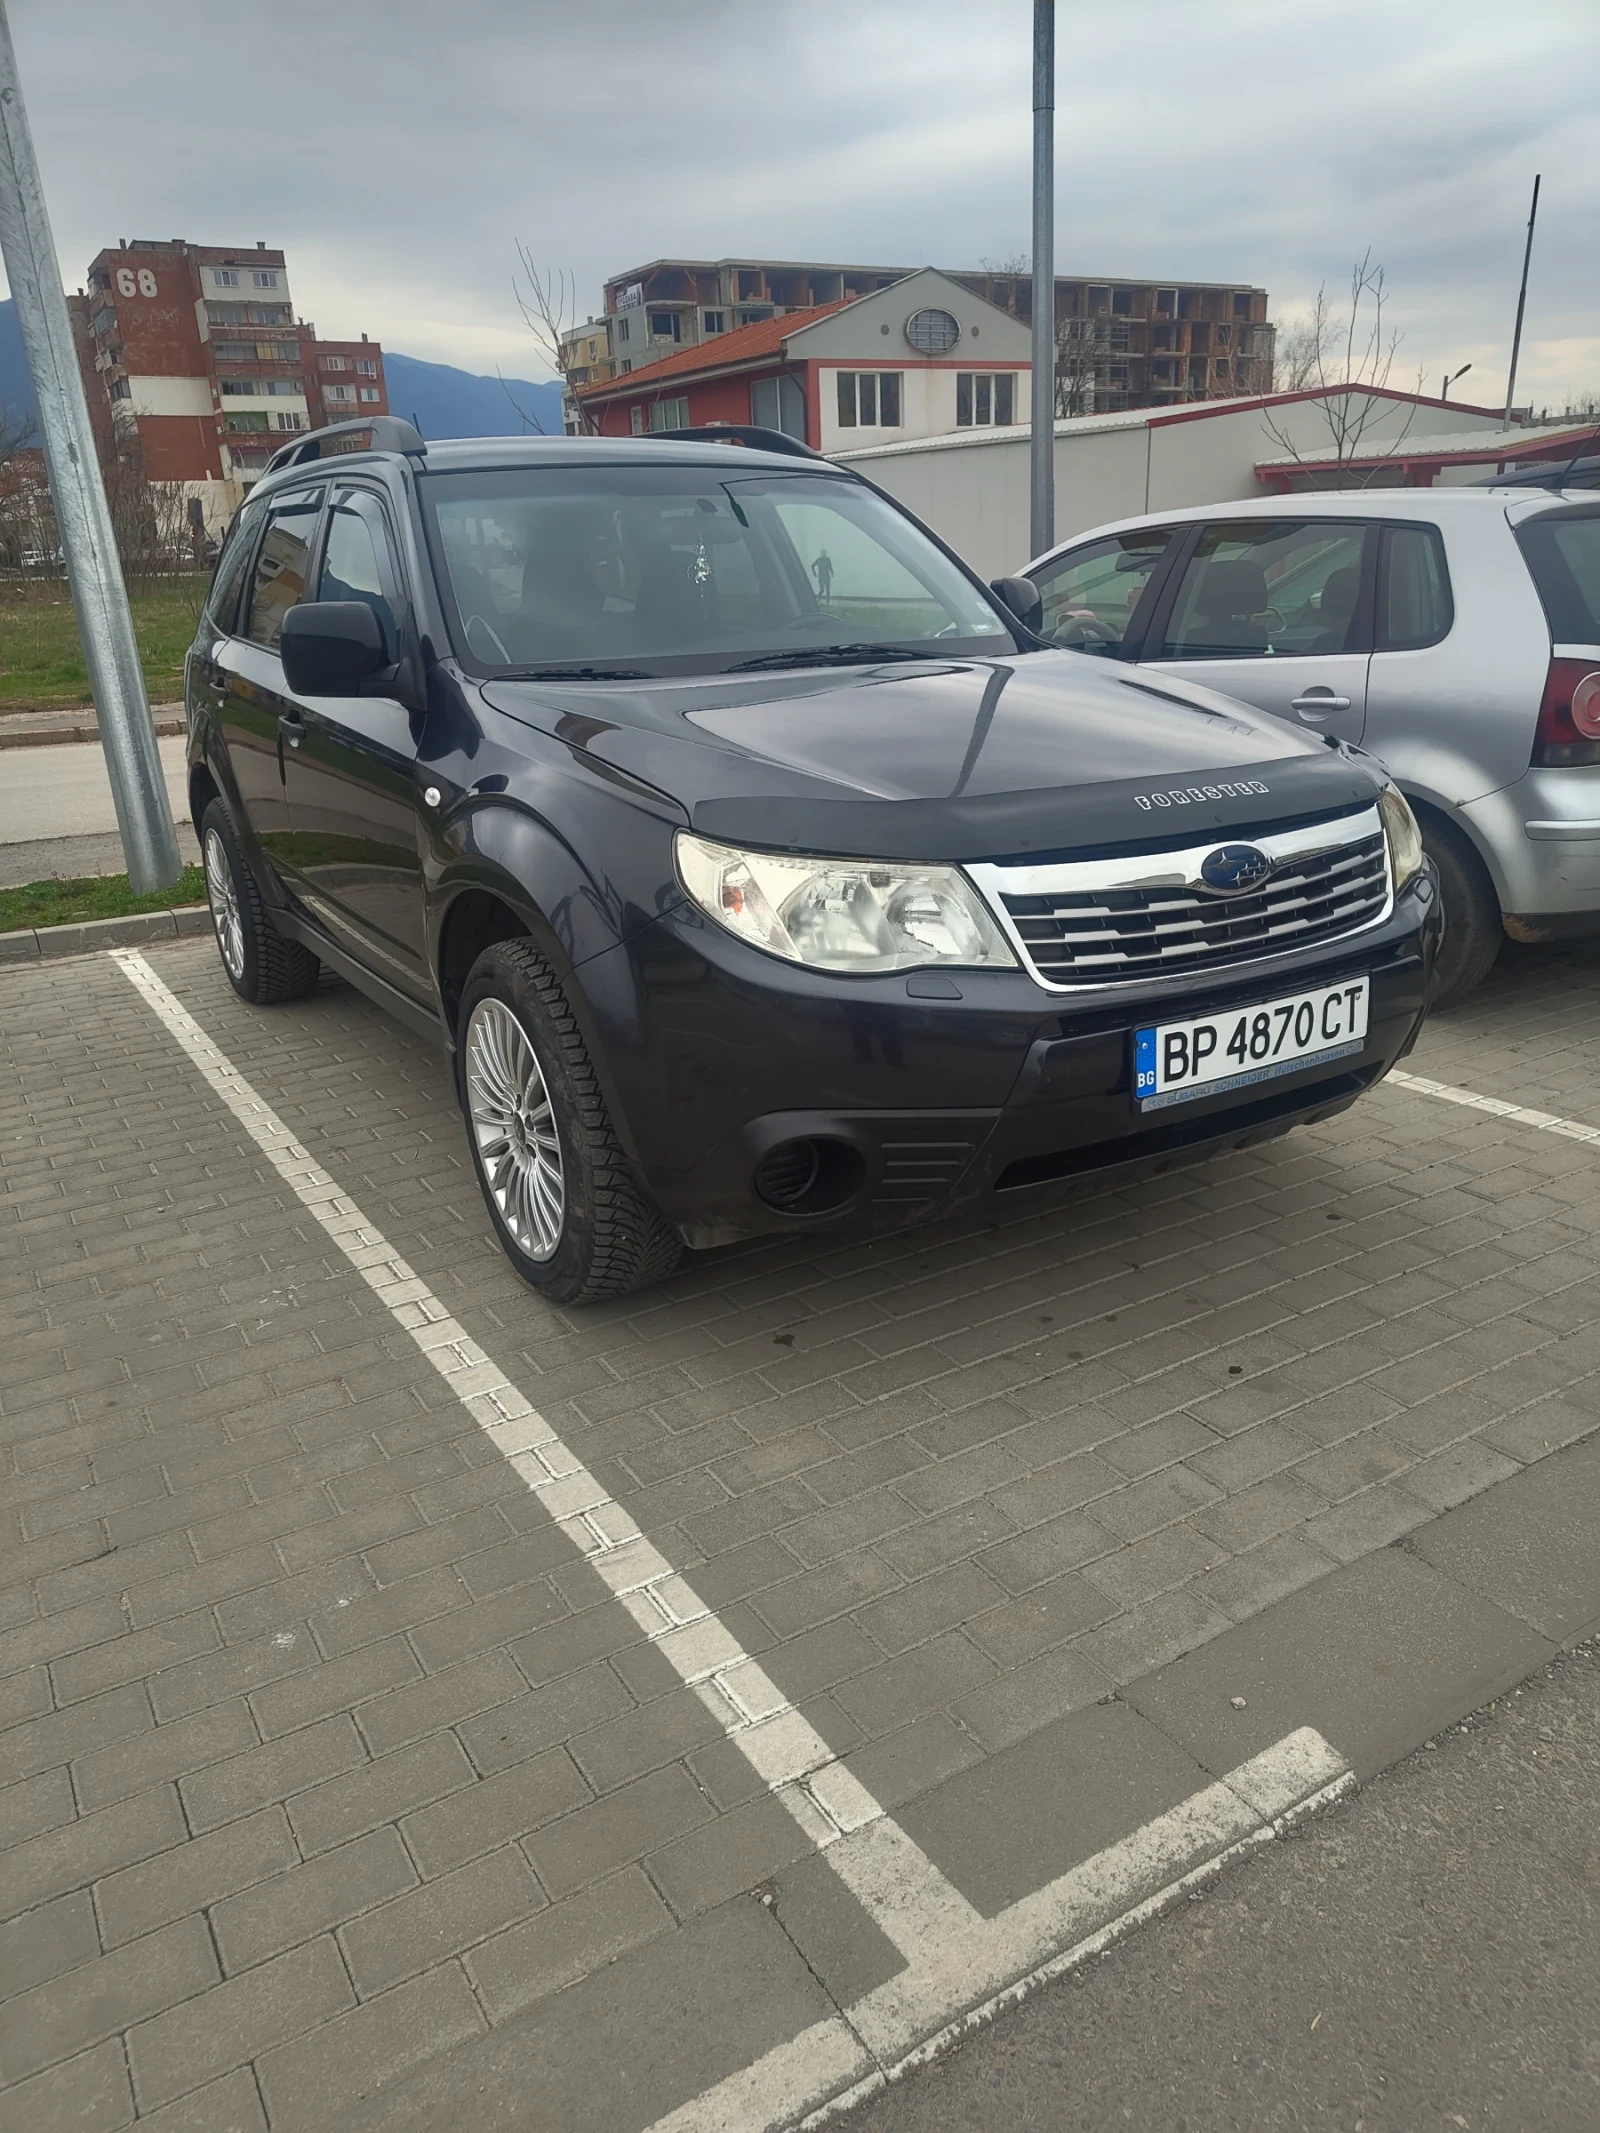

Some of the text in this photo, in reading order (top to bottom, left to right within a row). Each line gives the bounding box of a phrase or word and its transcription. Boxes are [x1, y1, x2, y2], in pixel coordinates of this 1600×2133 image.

[116, 268, 158, 298] 68
[1134, 781, 1270, 810] FORESTER
[1163, 985, 1364, 1083] BP 4870 CT
[1137, 1070, 1155, 1088] BG
[1167, 1086, 1211, 1105] SUBARU
[1214, 1069, 1270, 1093] SCHNEIDER
